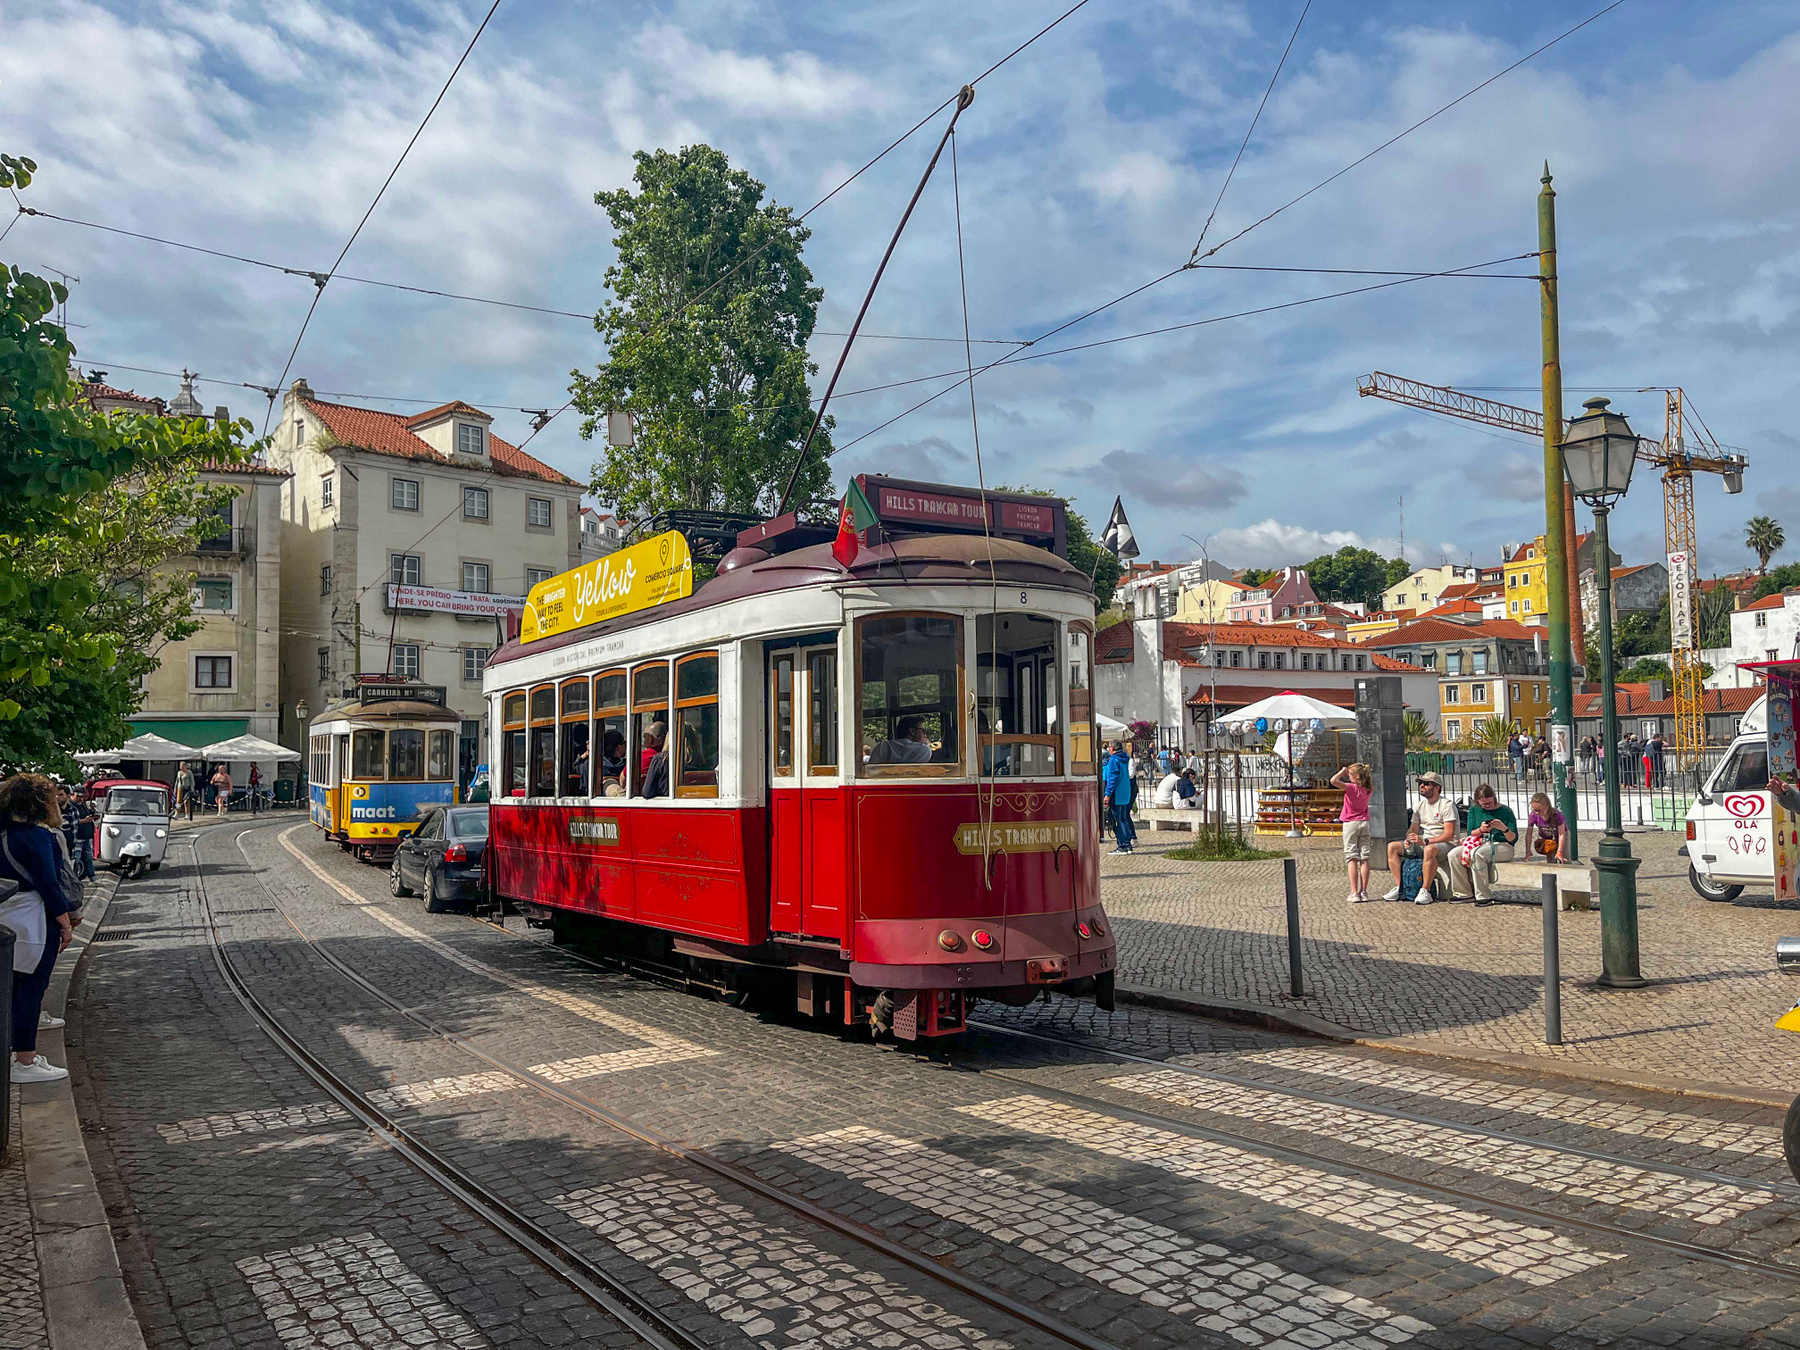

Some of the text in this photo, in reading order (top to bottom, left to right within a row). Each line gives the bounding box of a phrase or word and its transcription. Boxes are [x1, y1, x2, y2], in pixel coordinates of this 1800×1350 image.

[886, 495, 985, 519] HILLS TRAMCAR TOUR
[1018, 505, 1038, 514] LISBON
[1016, 513, 1040, 522] PREMIUM
[1016, 521, 1040, 530] TRAMCAR
[667, 563, 684, 577] SQUARE
[391, 587, 425, 597] VENDE-SE
[536, 587, 566, 606] THE BRIGHTER
[574, 558, 637, 623] Yellow
[1675, 564, 1686, 627] ECOCIAF
[1020, 592, 1027, 605] 8
[417, 599, 435, 608] YOU
[435, 601, 451, 609] CAN
[452, 603, 474, 612] BRING
[475, 604, 496, 614] YOUR
[536, 601, 564, 619] WAY TO FEEL
[540, 616, 560, 630] THE CITY.
[367, 688, 401, 697] CARREIRA
[352, 806, 396, 819] maat
[570, 821, 584, 839] HILLS
[603, 822, 618, 840] TOUR
[1005, 827, 1053, 846] TRAMCAR
[1053, 826, 1076, 843] TOUR
